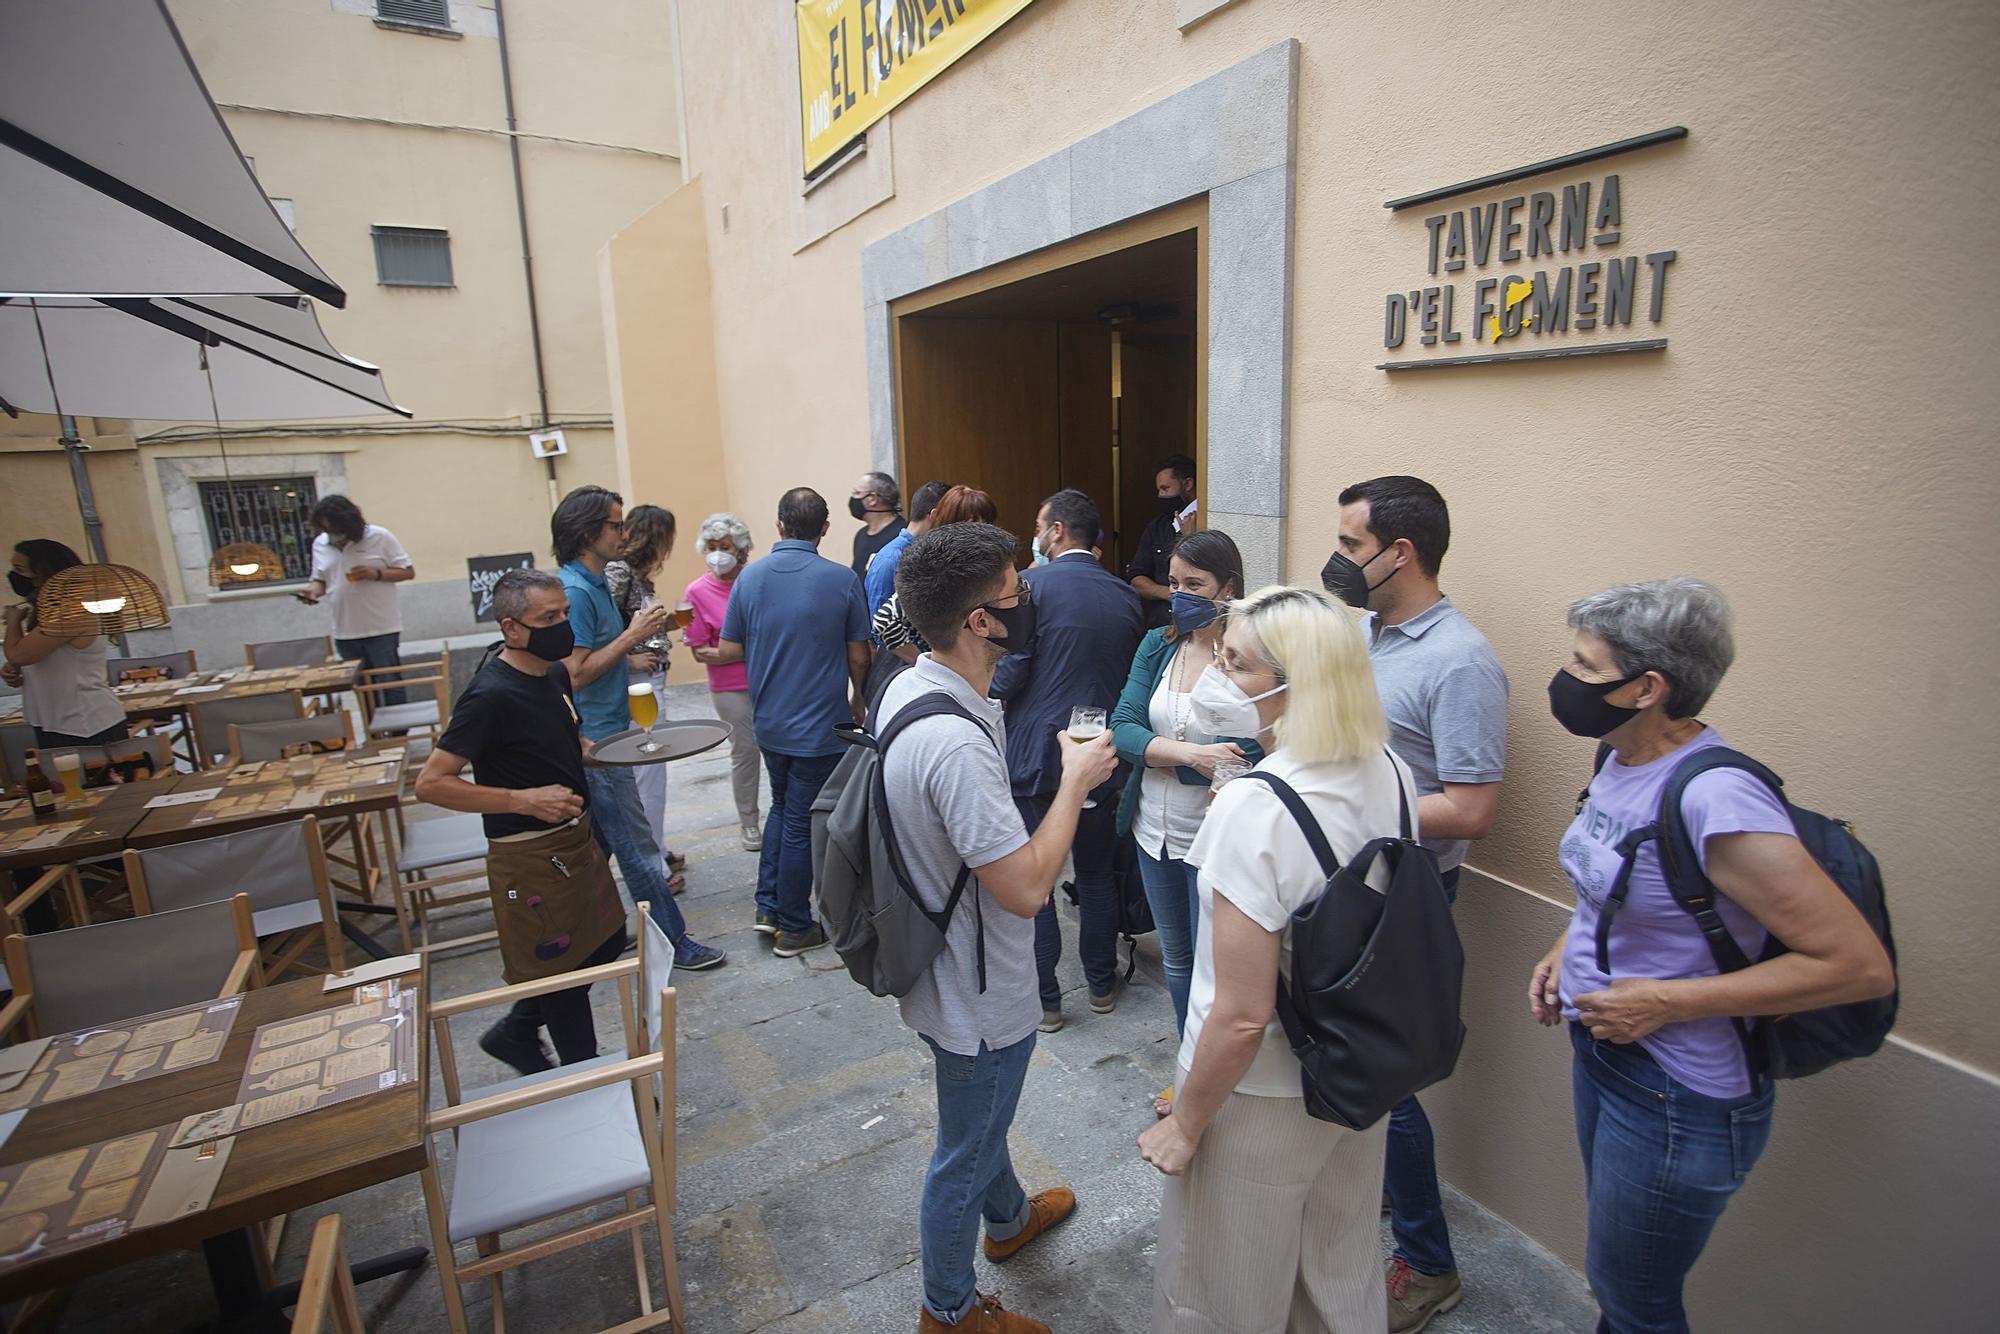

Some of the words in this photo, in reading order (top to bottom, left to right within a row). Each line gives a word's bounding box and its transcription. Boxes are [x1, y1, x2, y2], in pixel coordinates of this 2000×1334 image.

[829, 16, 856, 121] EL
[1424, 174, 1621, 275] TAVERNA
[1384, 284, 1461, 349] D'EL
[1473, 250, 1677, 343] FOMENT
